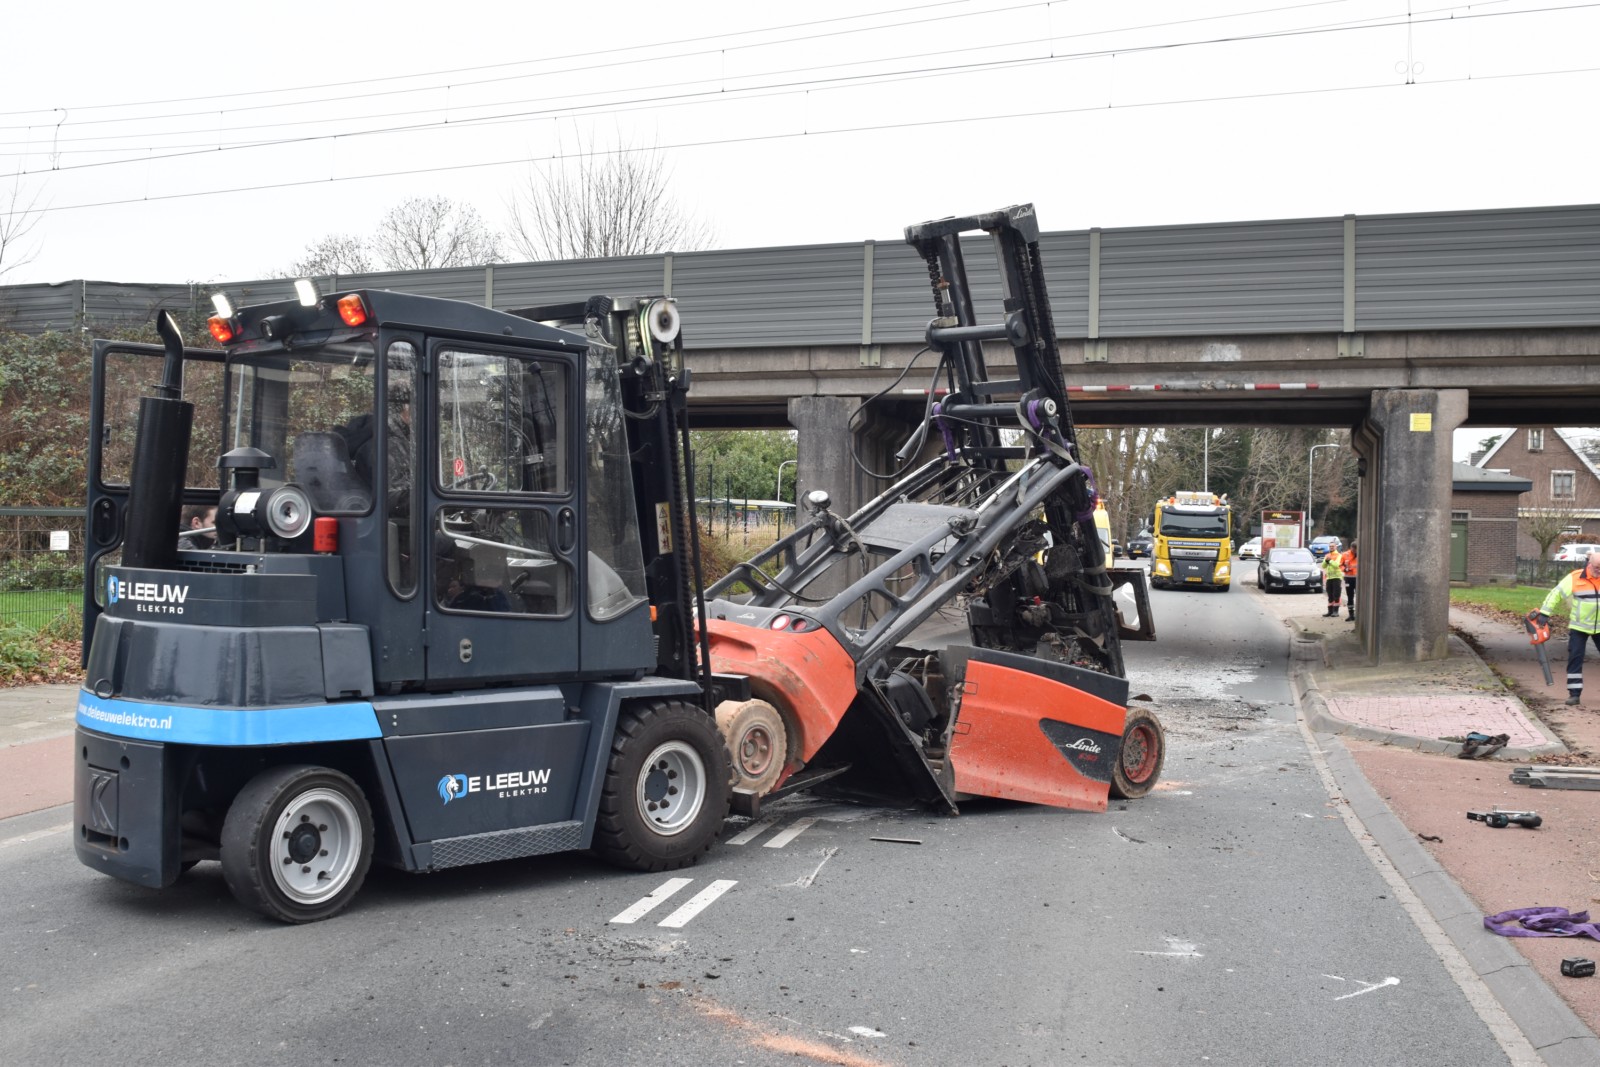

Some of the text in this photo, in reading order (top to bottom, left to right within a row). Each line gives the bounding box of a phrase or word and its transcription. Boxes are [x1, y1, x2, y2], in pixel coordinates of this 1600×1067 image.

[128, 582, 189, 604] LEEUW
[137, 604, 184, 615] ELEKTRO
[1066, 738, 1101, 753] Linde
[486, 768, 551, 791] LEEUW
[499, 786, 548, 798] ELEKTRO
